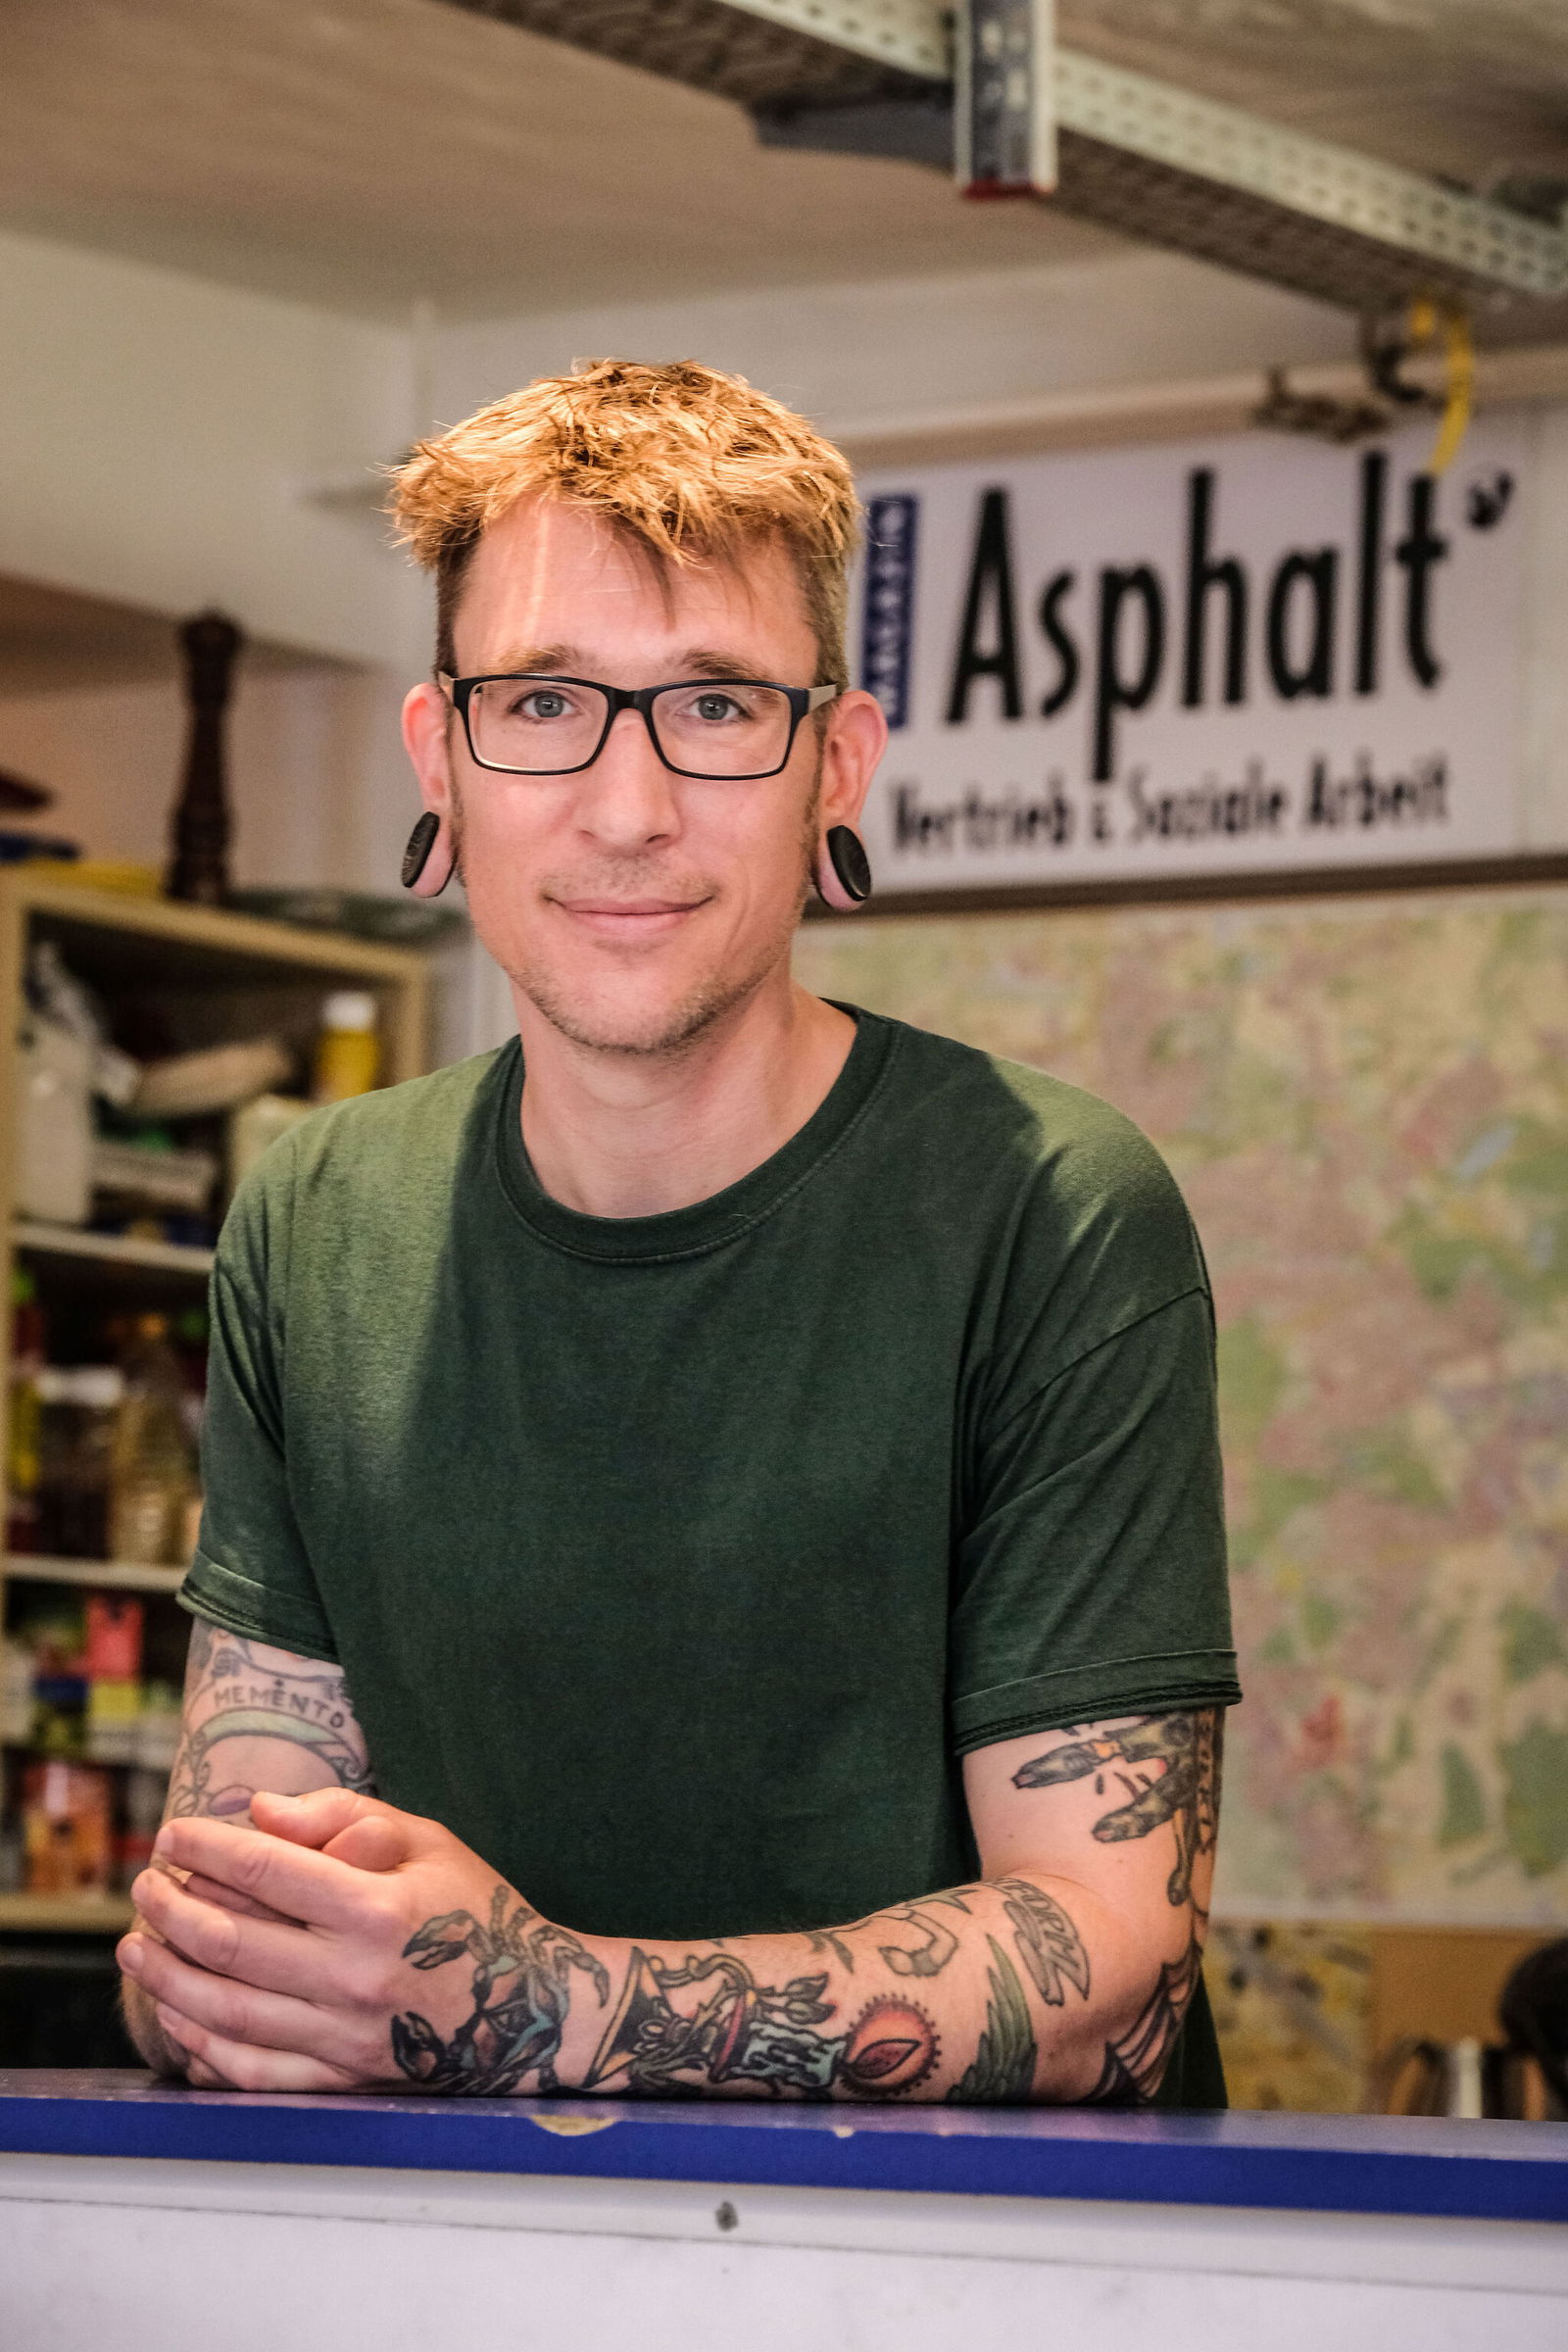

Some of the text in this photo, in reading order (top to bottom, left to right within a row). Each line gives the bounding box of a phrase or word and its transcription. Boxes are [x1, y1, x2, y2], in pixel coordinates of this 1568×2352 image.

[945, 449, 1447, 783] Asphalt
[890, 777, 1074, 855] Vertrieb
[1126, 761, 1289, 847] Soziale
[1303, 749, 1449, 832] Arbeit
[213, 1685, 345, 1730] MEMENTO
